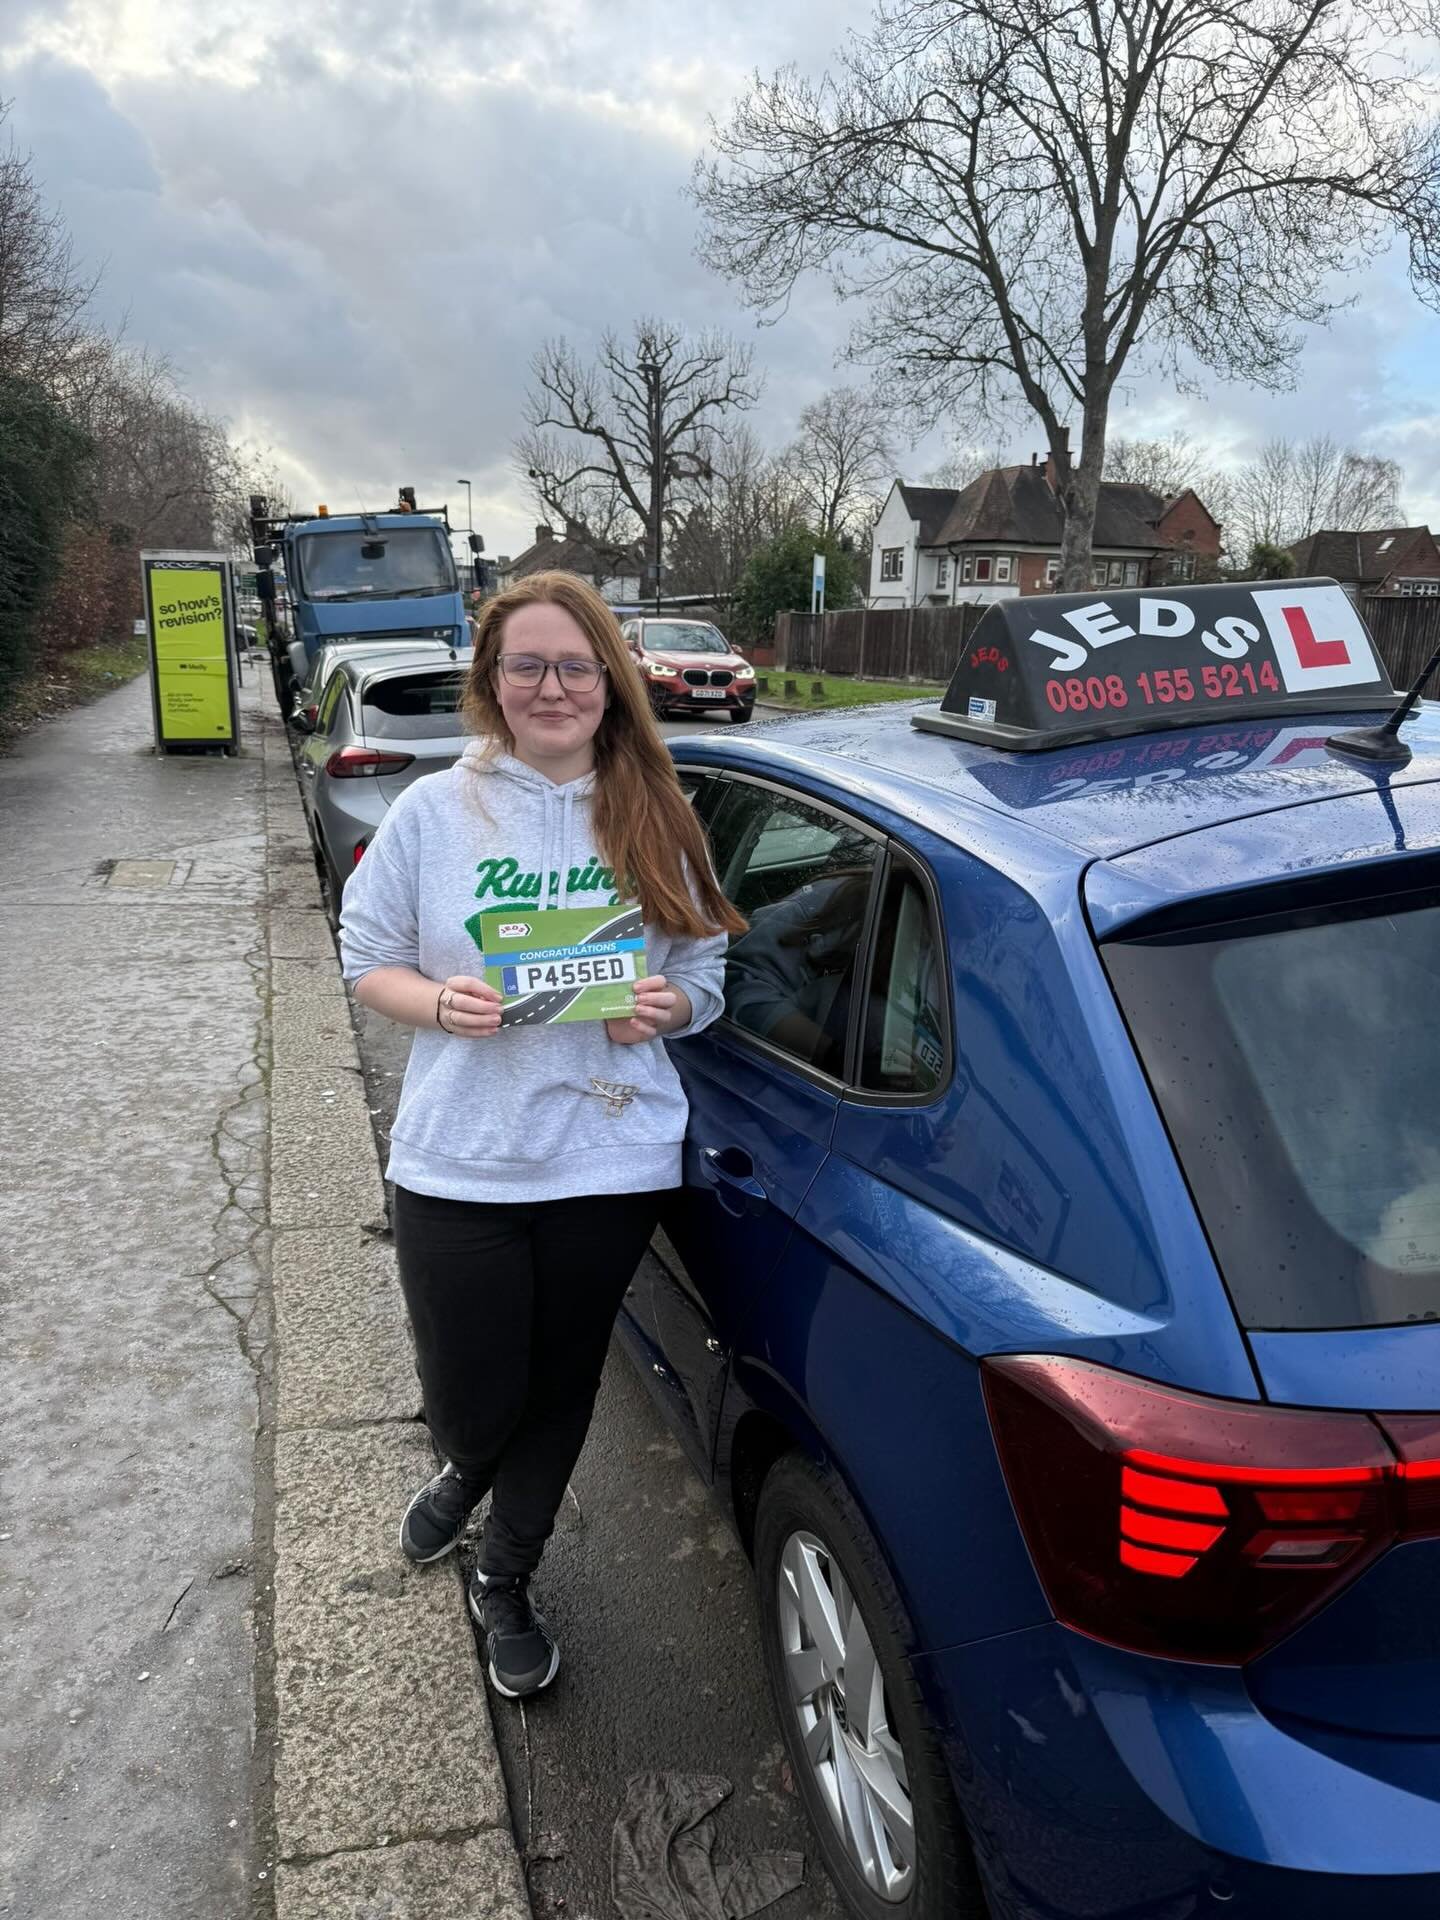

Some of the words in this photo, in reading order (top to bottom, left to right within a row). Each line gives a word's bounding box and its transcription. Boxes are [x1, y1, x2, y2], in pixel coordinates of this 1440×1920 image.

[159, 608, 222, 629] revision?
[160, 604, 177, 615] so
[177, 595, 220, 612] how's
[1029, 597, 1261, 673] JEDS
[1281, 605, 1352, 670] L
[970, 646, 1009, 673] JEDS
[1046, 674, 1129, 713] 0808
[1136, 667, 1195, 705] 155
[1201, 660, 1280, 699] 5214
[520, 942, 617, 961] CONGRATULATIONS
[527, 957, 625, 990] P455ED
